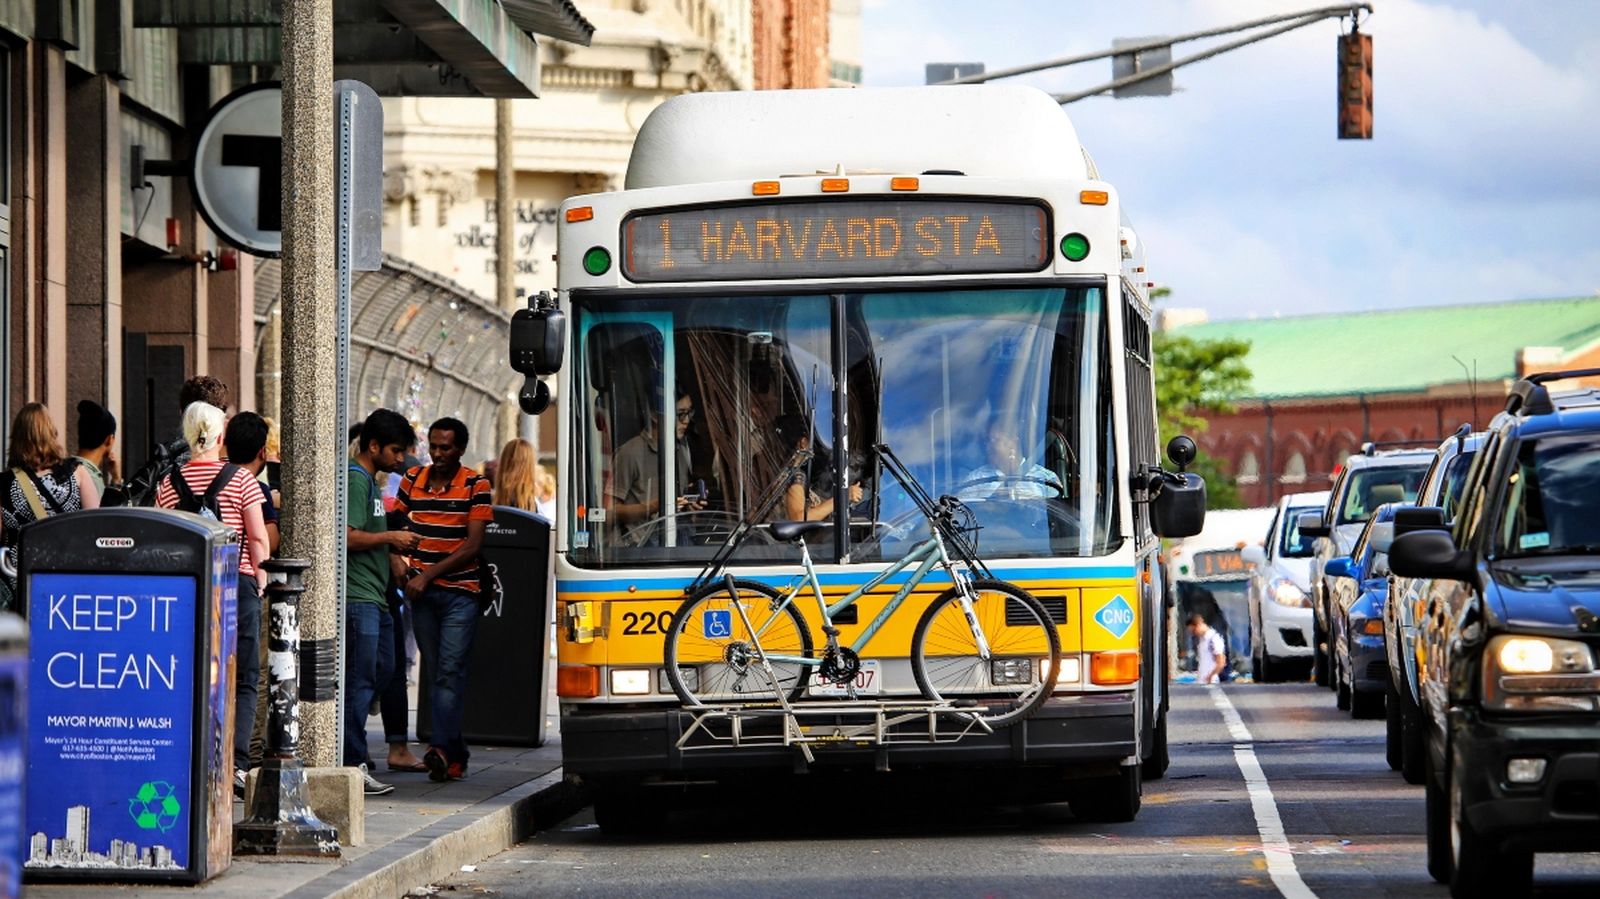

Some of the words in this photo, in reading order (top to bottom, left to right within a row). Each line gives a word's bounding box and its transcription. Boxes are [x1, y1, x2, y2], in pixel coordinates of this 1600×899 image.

[658, 218, 675, 269] 1
[702, 216, 900, 262] HARVARD
[914, 214, 1001, 257] STA
[49, 594, 137, 632] KEEP
[151, 596, 178, 632] IT
[1102, 608, 1131, 624] CNG
[47, 652, 175, 690] CLEAN
[47, 716, 86, 727] MAYOR
[88, 716, 128, 728] MARTIN
[137, 717, 172, 729] WALSH
